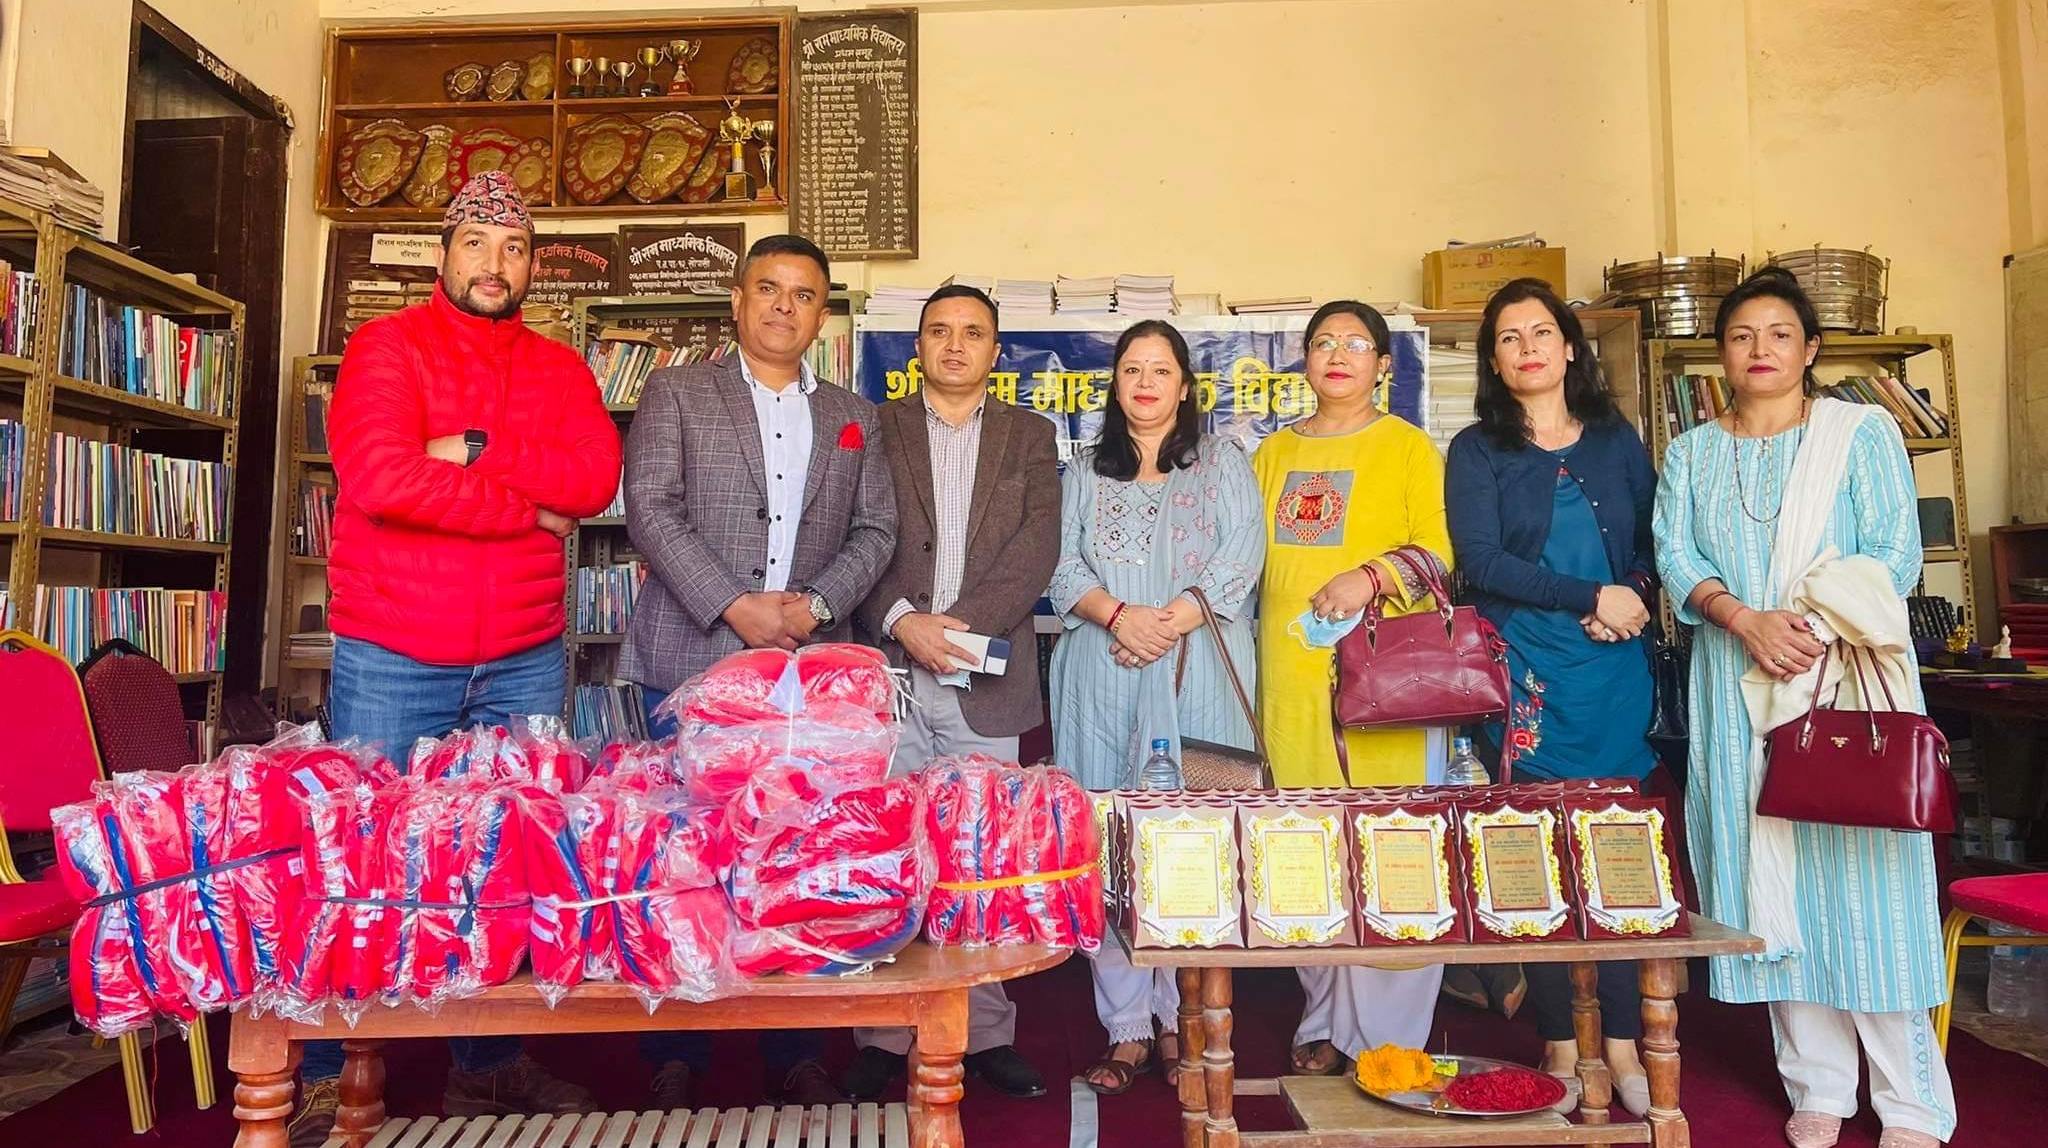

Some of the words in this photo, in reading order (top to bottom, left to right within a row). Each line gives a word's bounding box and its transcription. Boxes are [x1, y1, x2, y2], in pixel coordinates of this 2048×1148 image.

[629, 246, 643, 266] श्री
[658, 232, 705, 253] माध्यमिक
[704, 236, 738, 269] विद्यालय
